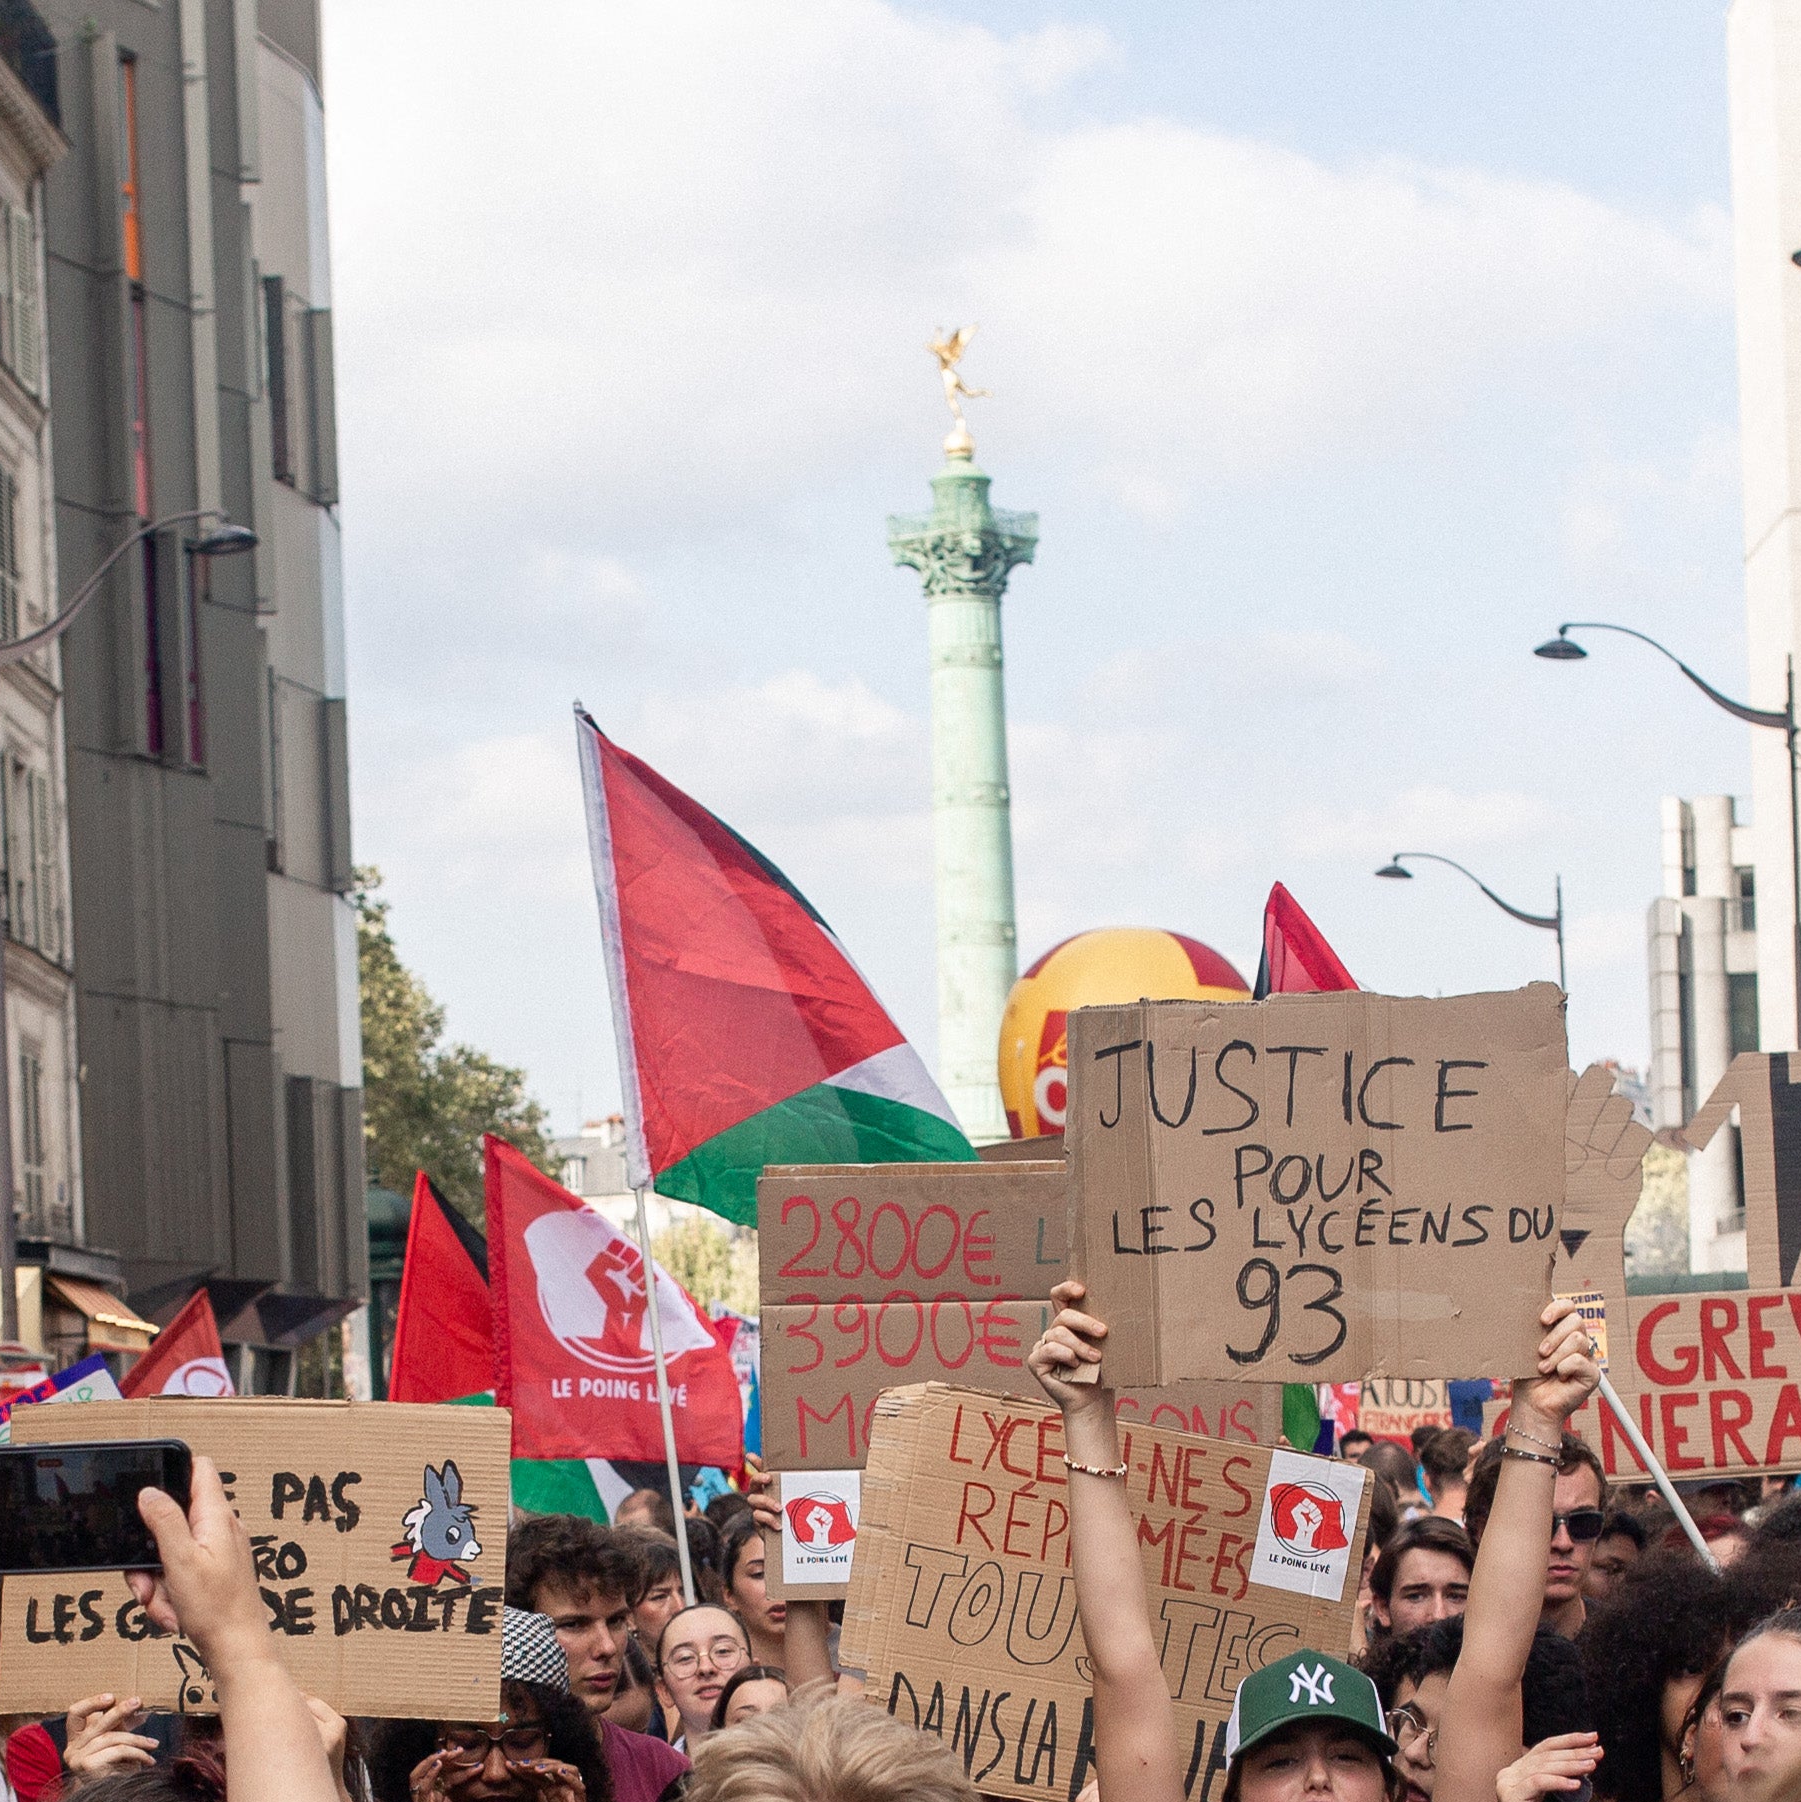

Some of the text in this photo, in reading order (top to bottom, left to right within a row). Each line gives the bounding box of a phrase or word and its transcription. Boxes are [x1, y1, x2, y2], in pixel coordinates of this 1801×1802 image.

[1094, 1040, 1489, 1136] JUSTICE
[1233, 1144, 1393, 1210] POUR
[777, 1196, 1003, 1286] 2800€
[1112, 1198, 1555, 1257] LES LYCÉENS DU
[785, 1288, 1023, 1374] 3900€
[1225, 1257, 1349, 1367] 93
[551, 1378, 572, 1399] LE
[579, 1378, 641, 1400] POING
[272, 1471, 363, 1532] PAS
[796, 1554, 848, 1564] LE POING LEVÉ
[1269, 1553, 1331, 1575] LE POING LEVÉ
[26, 1590, 104, 1644] LES
[332, 1585, 504, 1636] DROITE
[1288, 1661, 1336, 1705] NY
[888, 1671, 1012, 1784] DANS
[1015, 1699, 1057, 1787] LA
